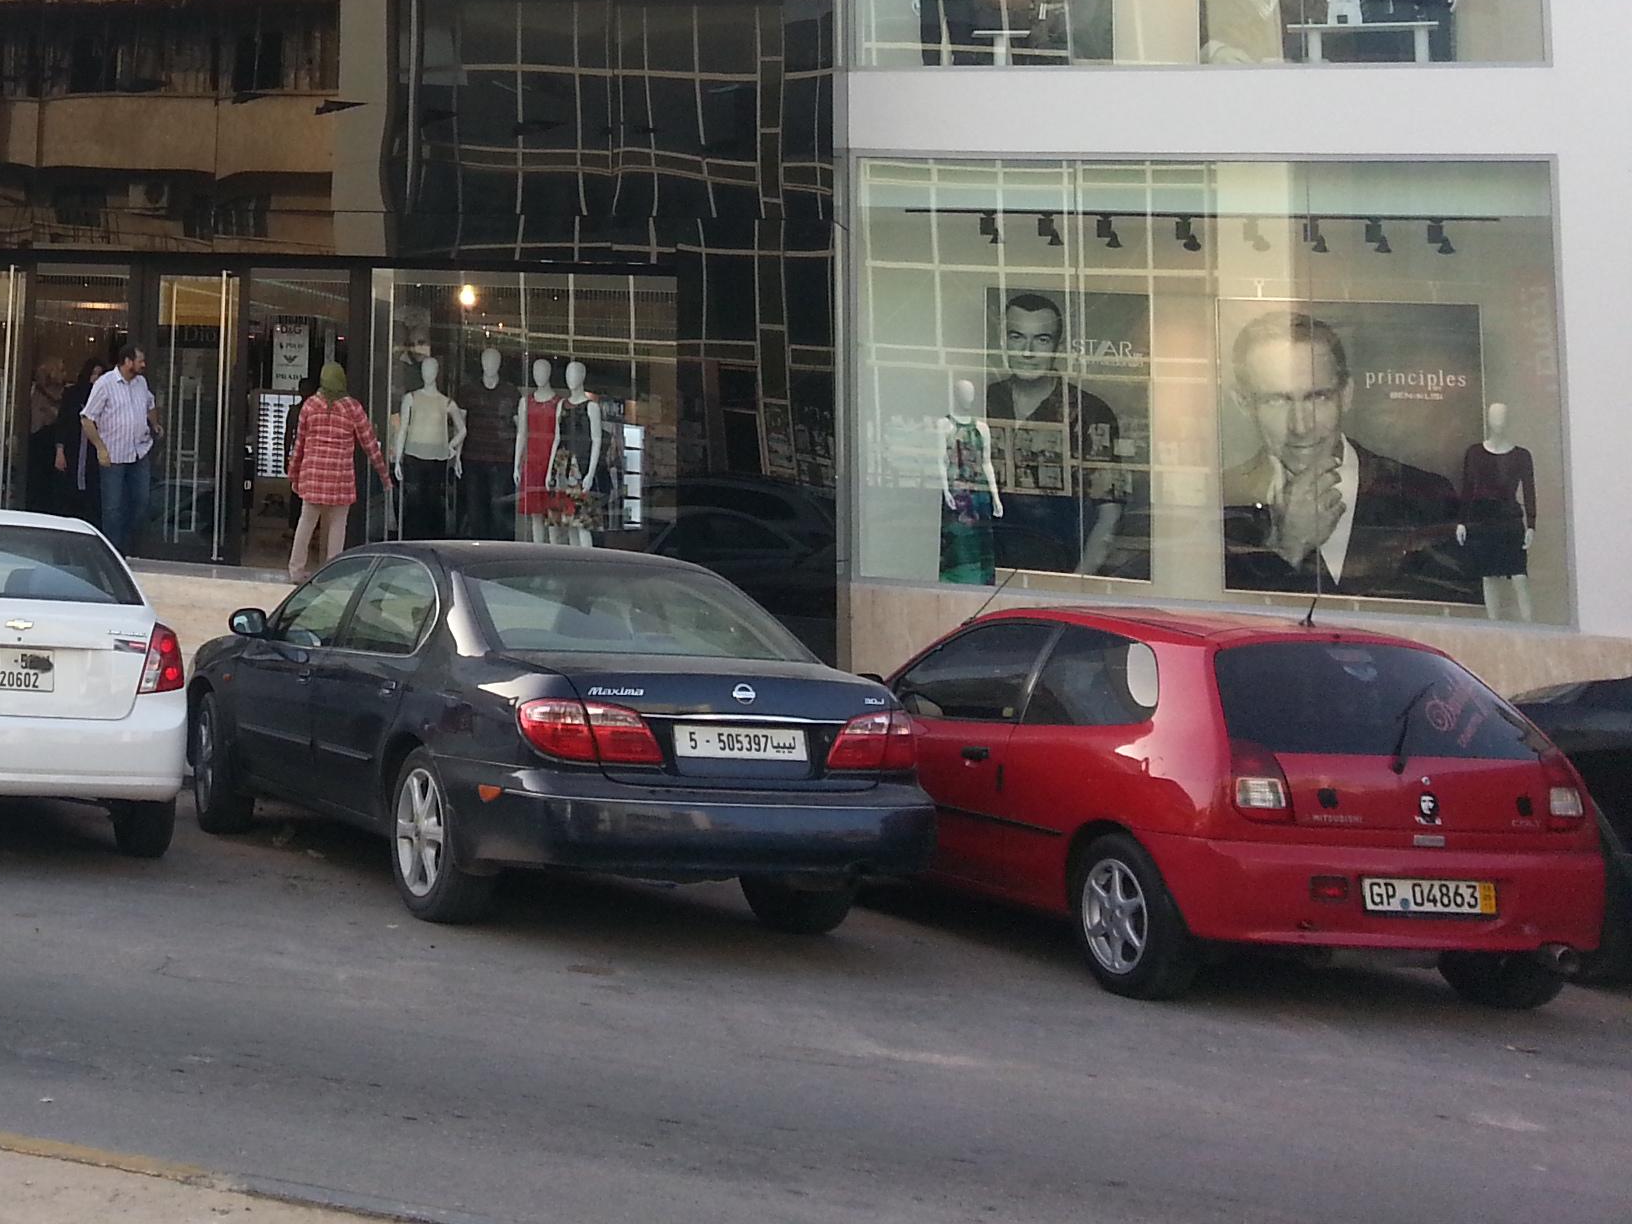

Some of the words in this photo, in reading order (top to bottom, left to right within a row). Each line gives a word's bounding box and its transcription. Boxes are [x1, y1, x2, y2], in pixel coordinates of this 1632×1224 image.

[183, 325, 218, 342] Dio
[1072, 339, 1132, 358] STAR
[1366, 370, 1467, 391] principles
[587, 686, 645, 696] Maxima
[688, 731, 698, 750] 5
[716, 732, 769, 753] 505397
[1369, 881, 1397, 907] GP
[1411, 882, 1479, 909] 04863
